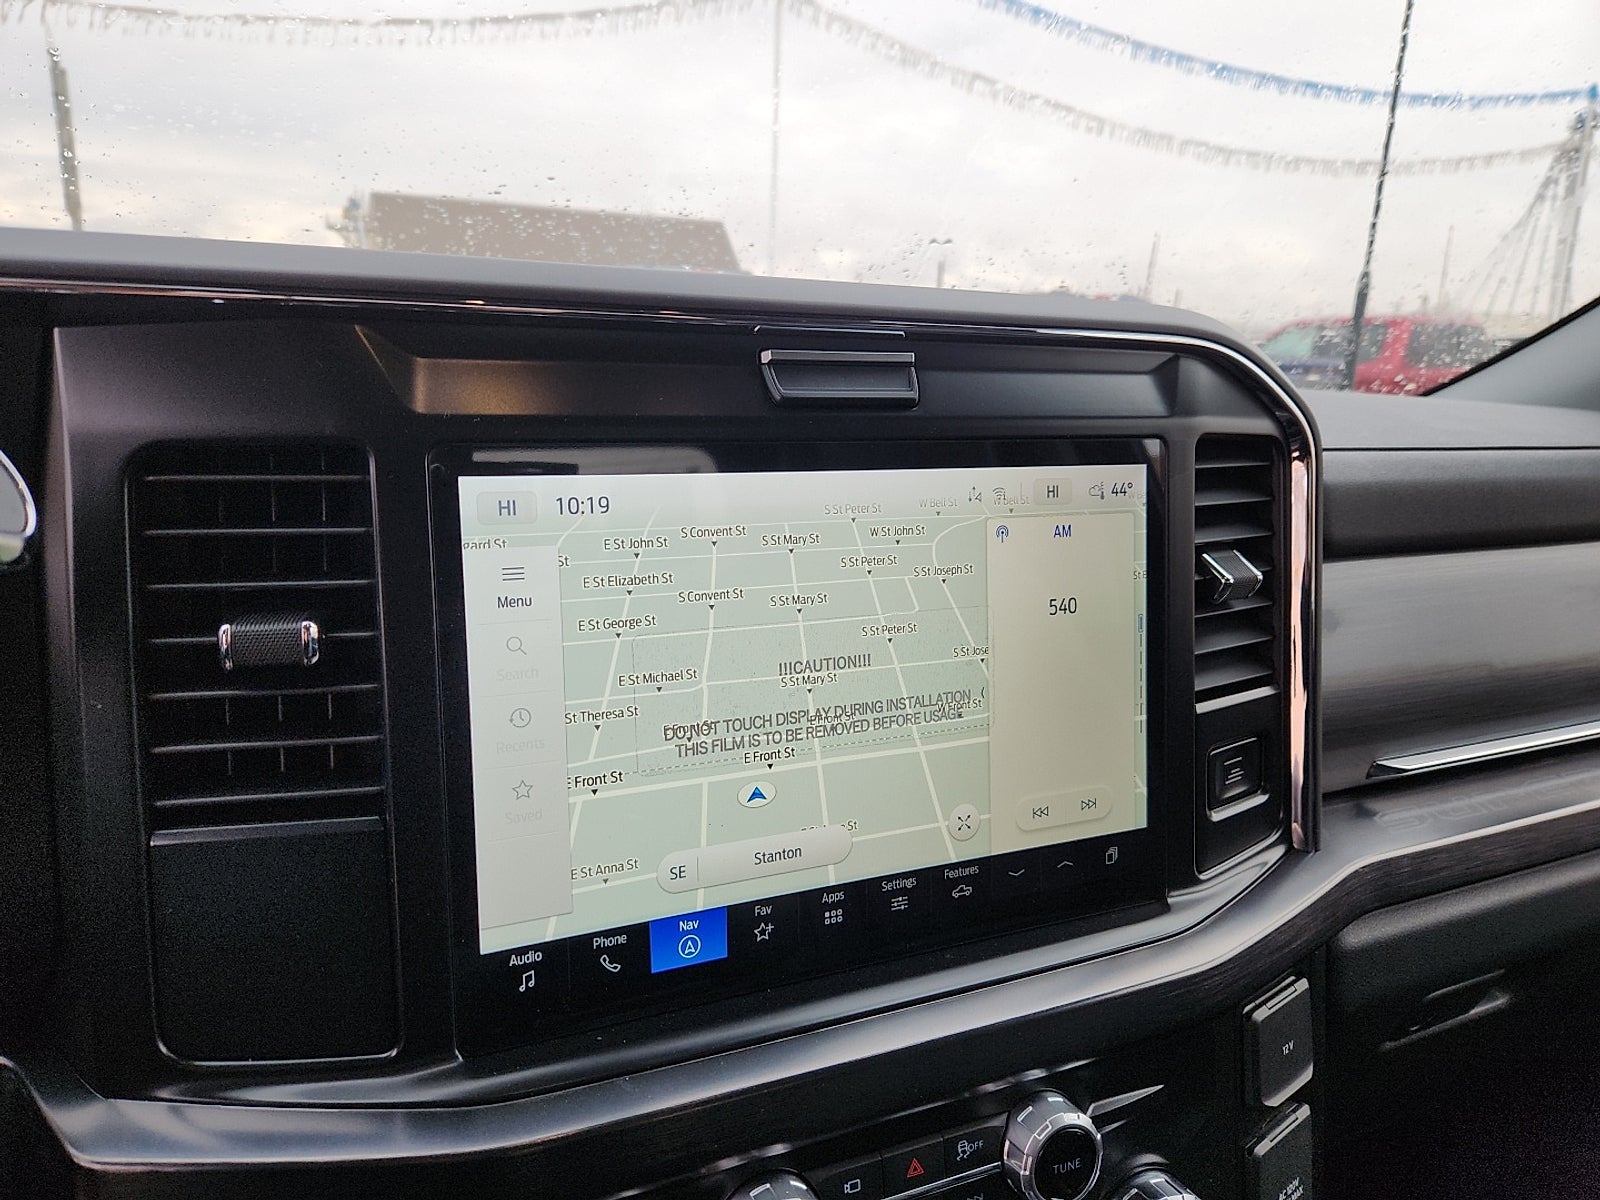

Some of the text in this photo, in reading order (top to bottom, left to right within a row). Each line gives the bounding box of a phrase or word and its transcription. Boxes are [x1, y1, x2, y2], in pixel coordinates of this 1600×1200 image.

[1047, 486, 1059, 498] HI
[498, 500, 517, 516] HI
[556, 496, 610, 516] 10:19
[824, 503, 882, 515] S St Peter St
[681, 525, 747, 538] S Convent St
[870, 525, 926, 537] W St John St
[1053, 525, 1072, 538] AM
[604, 536, 669, 550] E St John St
[762, 534, 820, 547] S St Mary St
[840, 555, 898, 568] S St Peter St
[914, 564, 974, 578] S St Joseph St
[583, 572, 674, 588] E St Elizabeth St
[497, 596, 532, 609] Menu
[678, 588, 744, 603] S Convent St
[770, 593, 828, 608] S St Mary St
[1048, 597, 1078, 616] 540
[578, 615, 657, 632] E St George St
[862, 623, 918, 637] S St Peter St
[953, 648, 958, 658] S
[960, 646, 970, 657] St
[618, 668, 698, 686] E St Michael St
[780, 673, 838, 688] S St Mary St
[972, 698, 982, 708] St
[580, 708, 624, 723] Theresa
[626, 706, 640, 718] St
[722, 714, 772, 734] TOUCH
[776, 706, 832, 726] DISPLAY
[834, 700, 884, 718] DURING
[886, 688, 971, 712] INSTALLATION
[675, 708, 964, 758] THIS FILM IS TO BE REMOVED BEFORE USAGE
[744, 746, 796, 764] E Front St
[574, 772, 608, 788] Front
[610, 770, 624, 784] St
[848, 820, 858, 831] St
[571, 858, 639, 880] E St Anna St
[669, 848, 802, 880] SE Stanton
[944, 864, 980, 880] Features
[882, 876, 917, 892] Settings
[822, 890, 844, 904] Apps
[754, 904, 772, 916] Fav
[679, 920, 700, 932] Nav
[593, 934, 628, 949] Phone
[509, 950, 542, 966] Audio
[966, 1140, 984, 1152] OFF
[1052, 1158, 1081, 1175] TUNE
